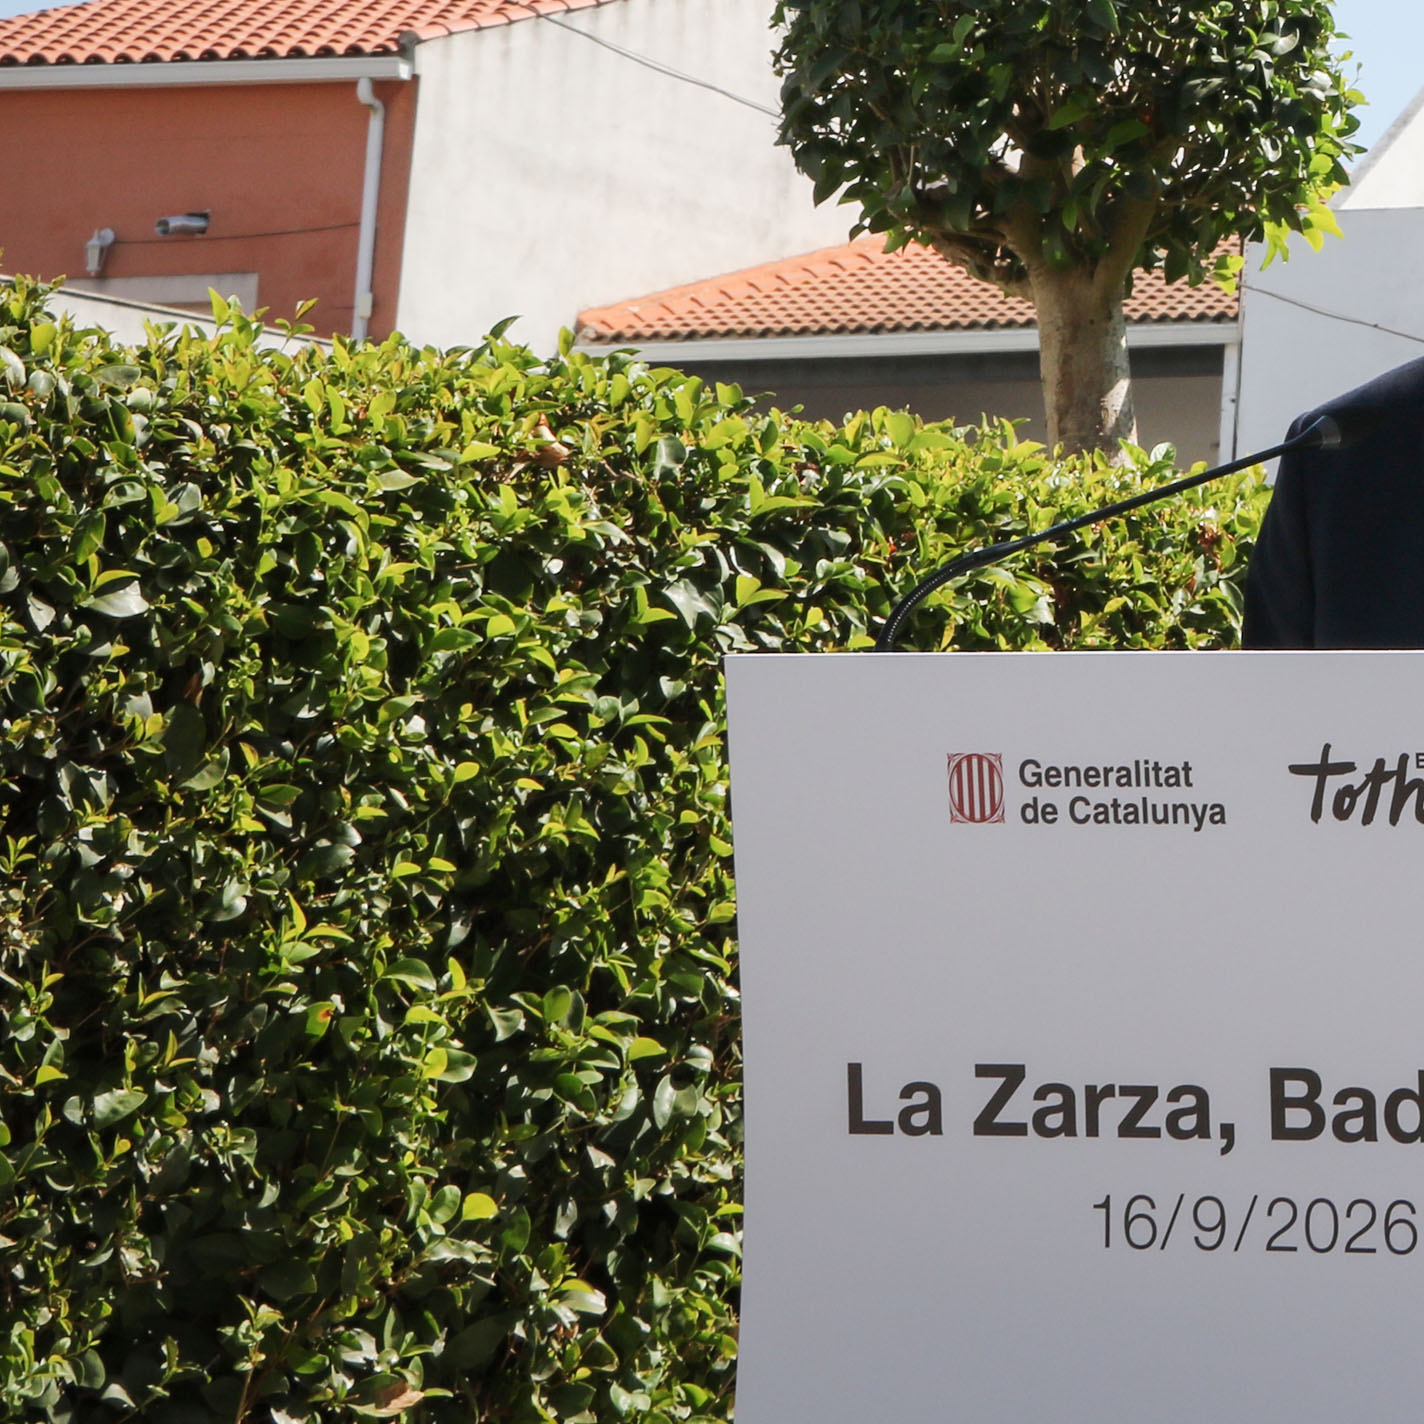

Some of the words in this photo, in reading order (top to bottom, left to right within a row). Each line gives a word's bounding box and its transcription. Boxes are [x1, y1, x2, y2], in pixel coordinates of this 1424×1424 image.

[1018, 758, 1194, 788] Generalitat
[1020, 796, 1059, 825] de
[1068, 795, 1227, 833] Catalunya
[847, 1062, 944, 1137] La
[973, 1063, 1235, 1156] Zarza,
[1092, 1193, 1418, 1256] 16/9/2026
